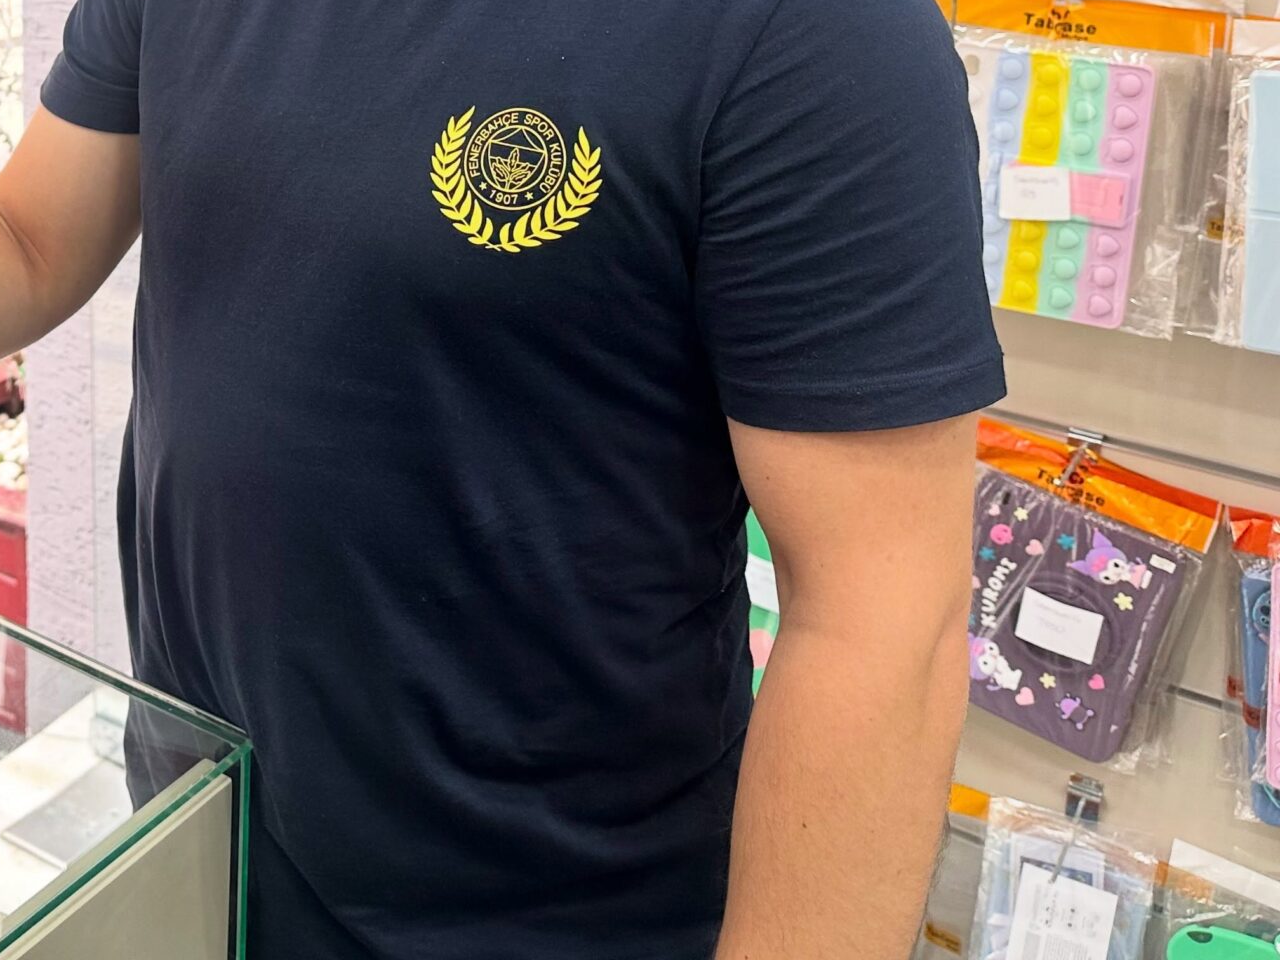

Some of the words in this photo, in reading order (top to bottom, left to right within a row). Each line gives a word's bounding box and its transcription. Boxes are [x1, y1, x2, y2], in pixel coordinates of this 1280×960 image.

[468, 112, 519, 178] FENERBAHÇE
[523, 113, 555, 141] SPOR
[539, 142, 563, 194] KULÜBÜ
[489, 189, 519, 205] 1907
[980, 557, 1017, 629] KUROMI
